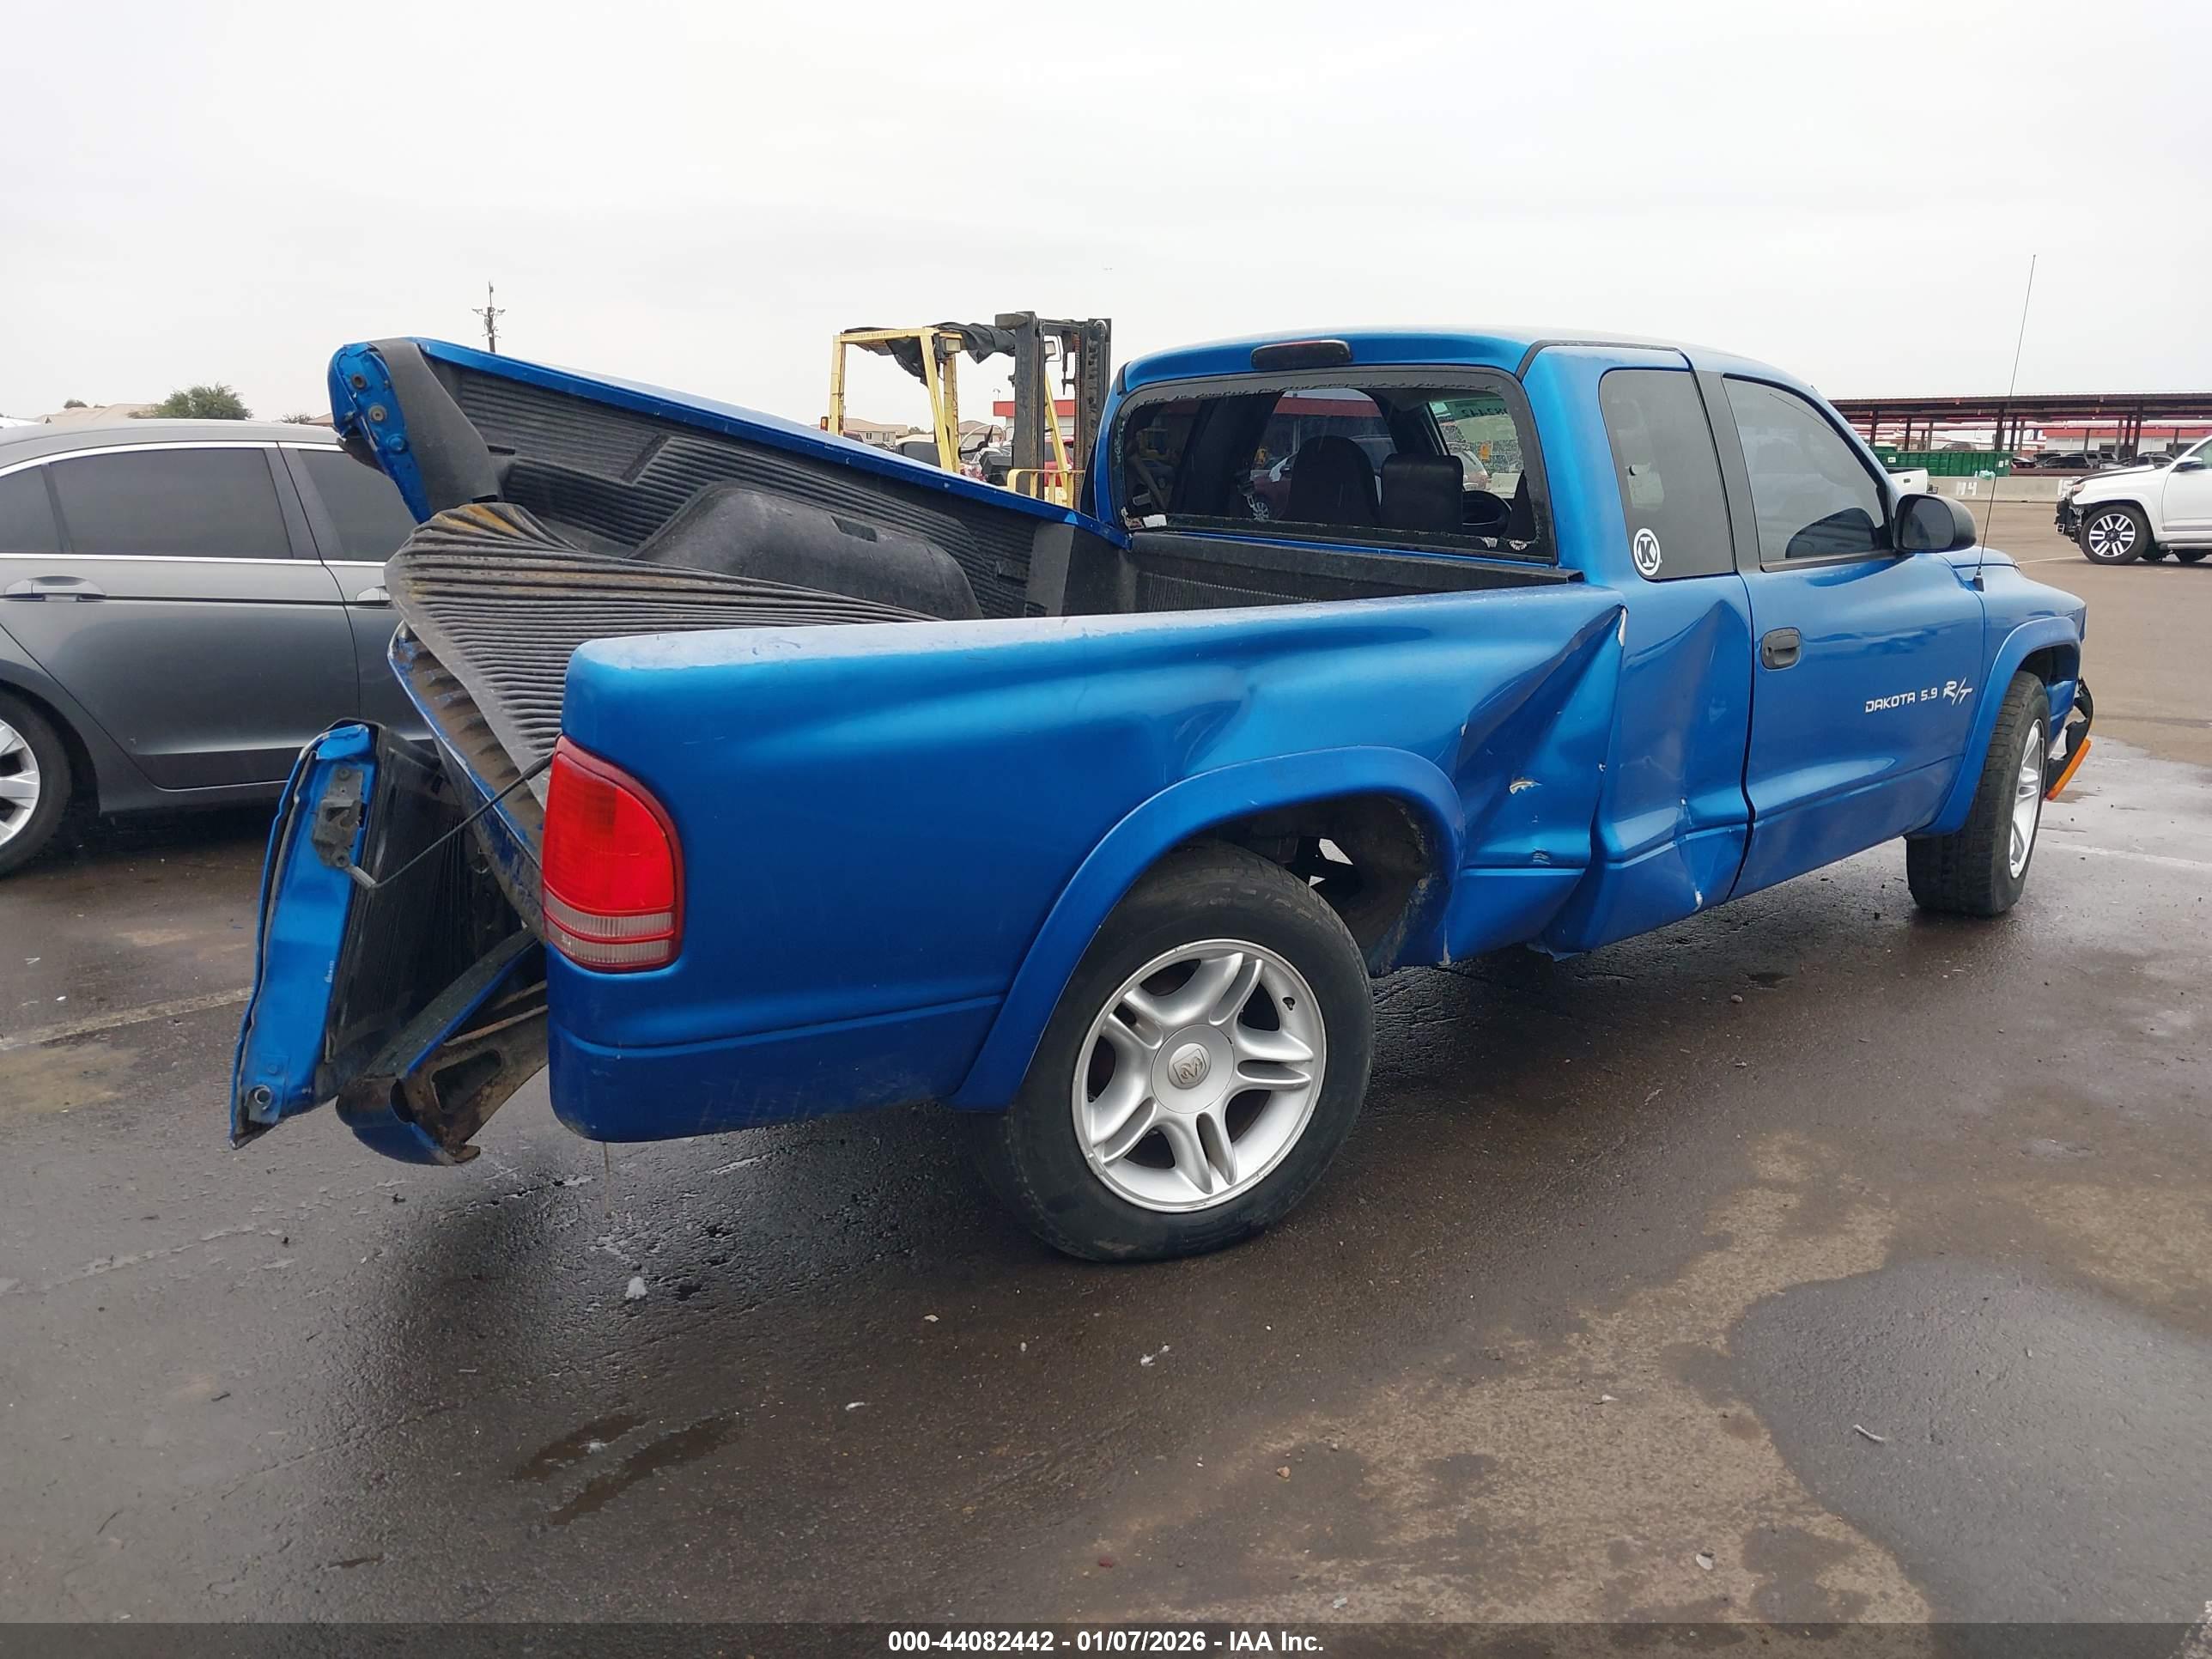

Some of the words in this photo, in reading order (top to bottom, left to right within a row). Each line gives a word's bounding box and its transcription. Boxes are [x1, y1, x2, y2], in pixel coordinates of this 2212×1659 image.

[1865, 692, 1916, 713] DAKOTA
[1920, 688, 1938, 702] 5.9
[1942, 677, 1973, 706] R/T
